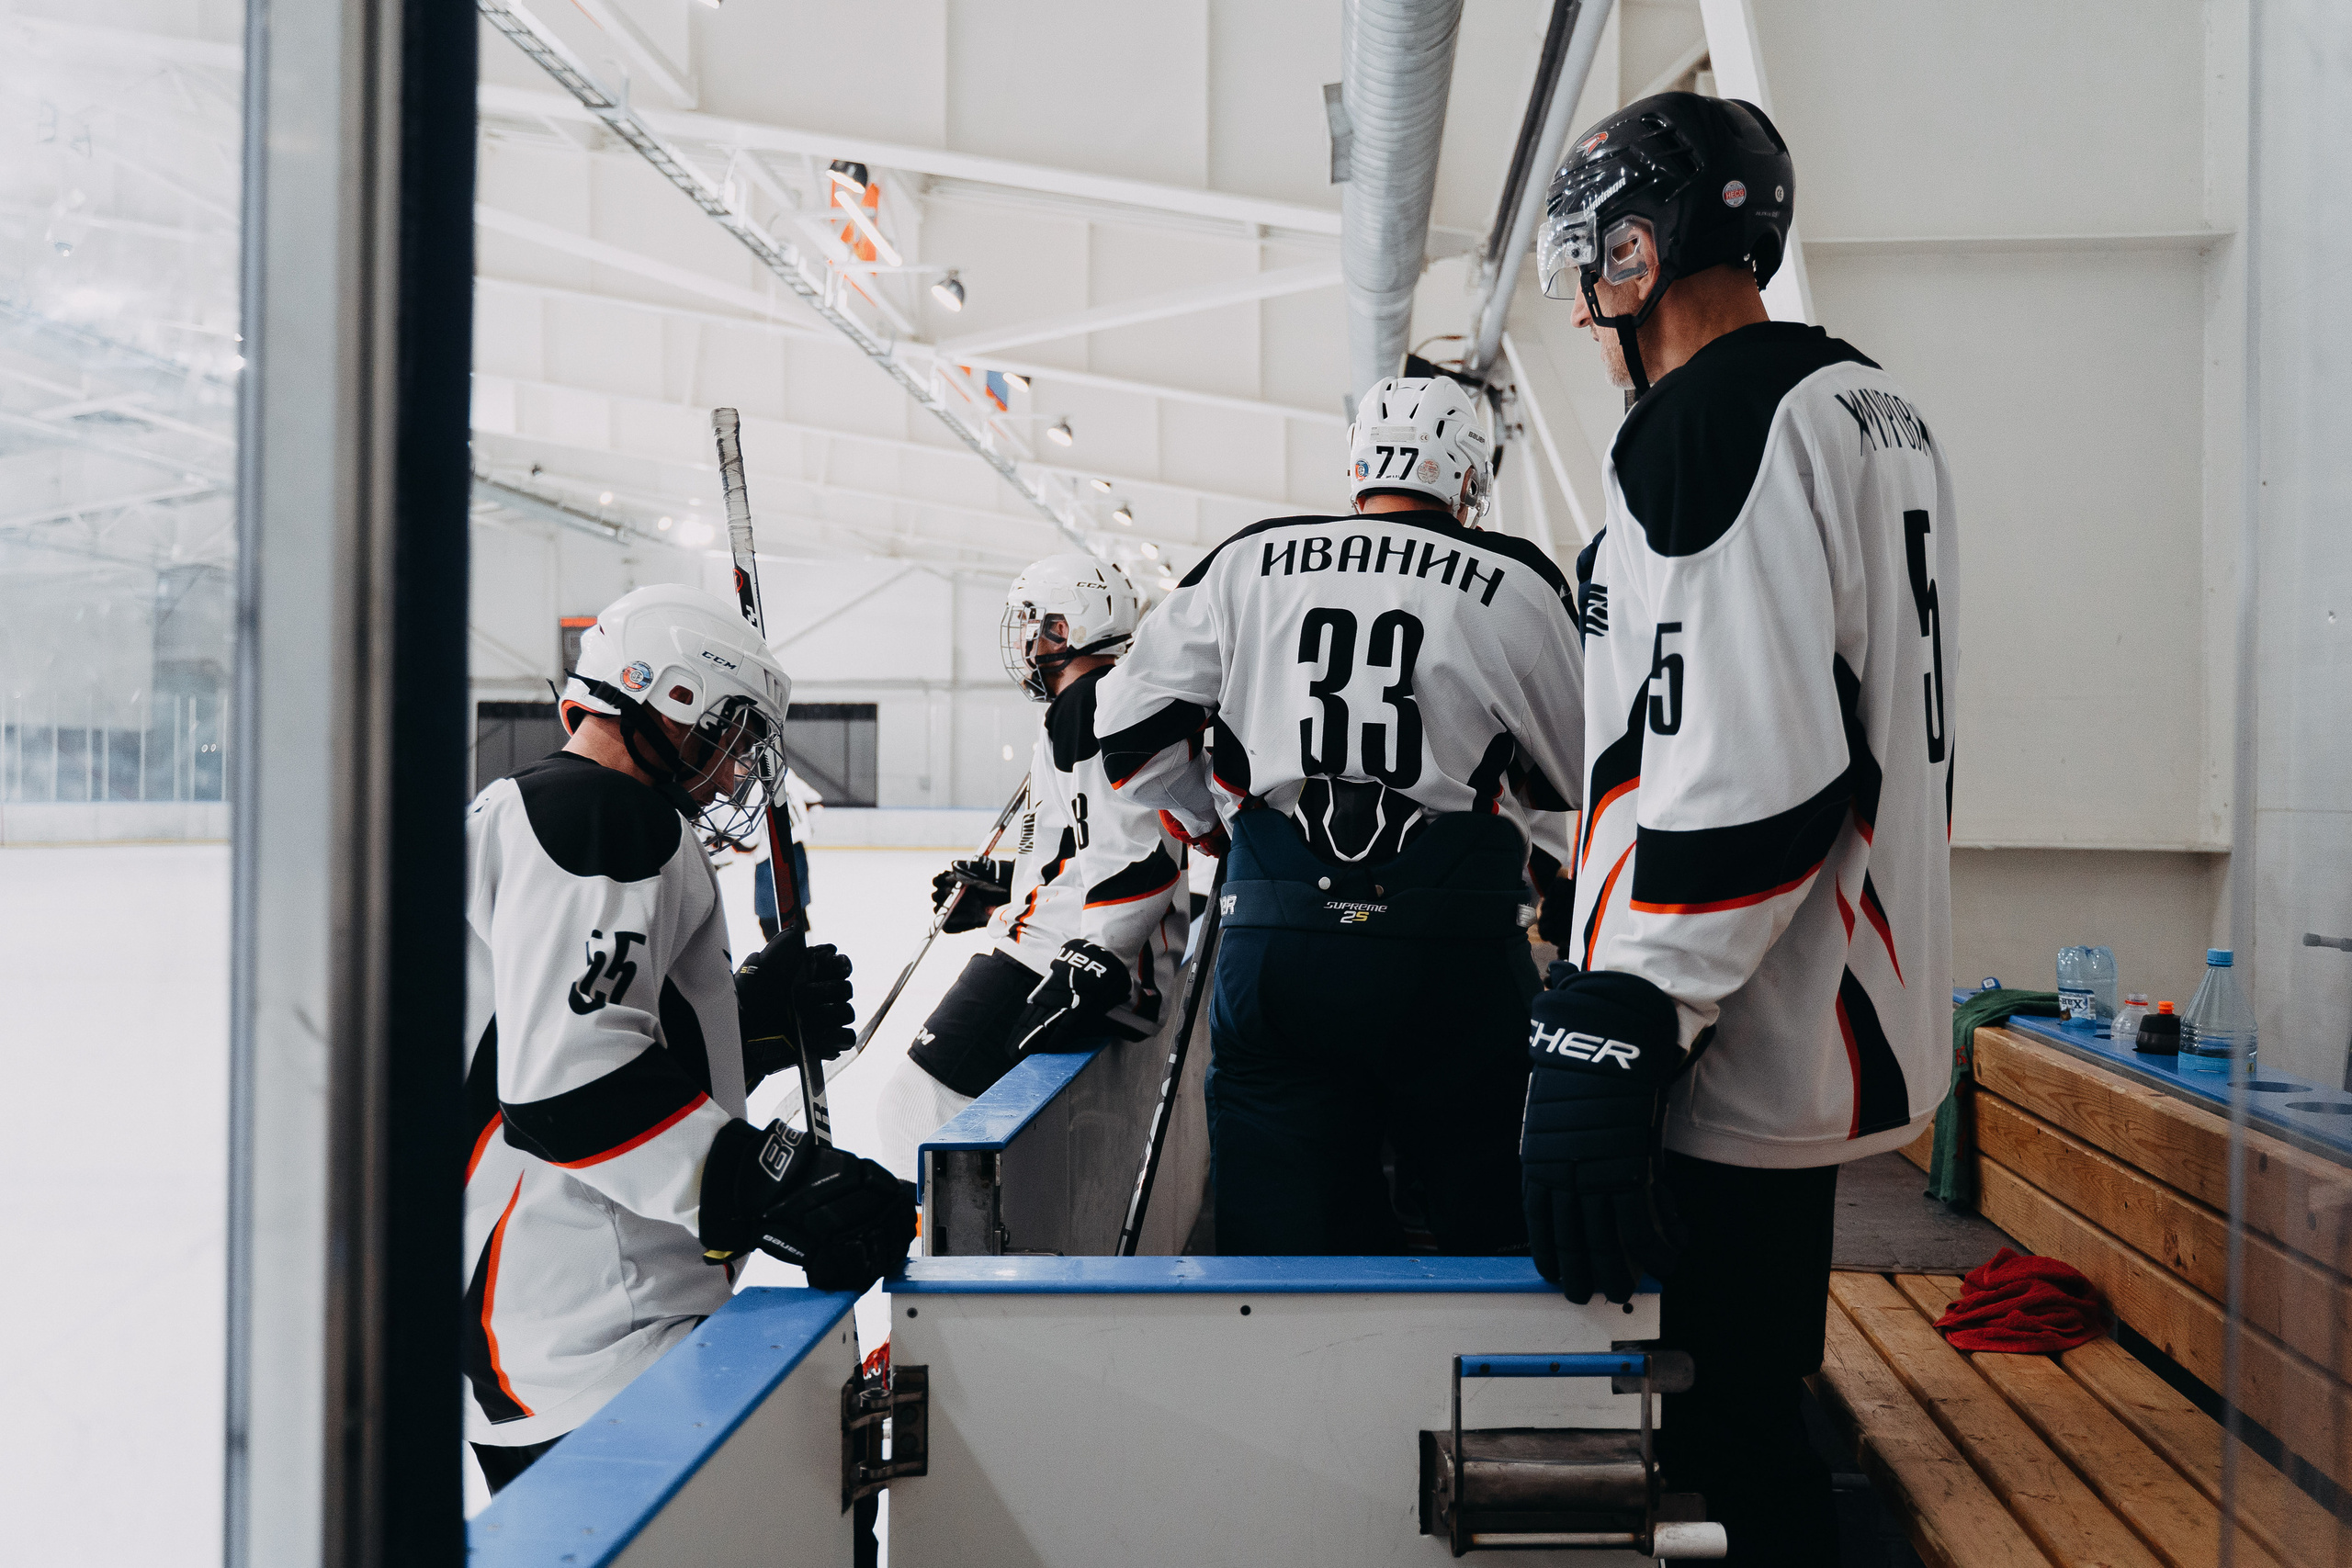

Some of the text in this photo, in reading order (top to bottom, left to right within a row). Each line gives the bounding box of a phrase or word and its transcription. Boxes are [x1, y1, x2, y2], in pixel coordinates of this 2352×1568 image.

[1374, 445, 1419, 480] 77
[1076, 581, 1108, 591] CCM
[1261, 535, 1506, 608] ИВАНИН
[1903, 509, 1945, 763] 5
[701, 650, 737, 671] CCM
[1648, 621, 1685, 736] 5
[1297, 606, 1425, 790] 33
[1323, 901, 1388, 913] SUPREME
[762, 1234, 806, 1258] BAUER
